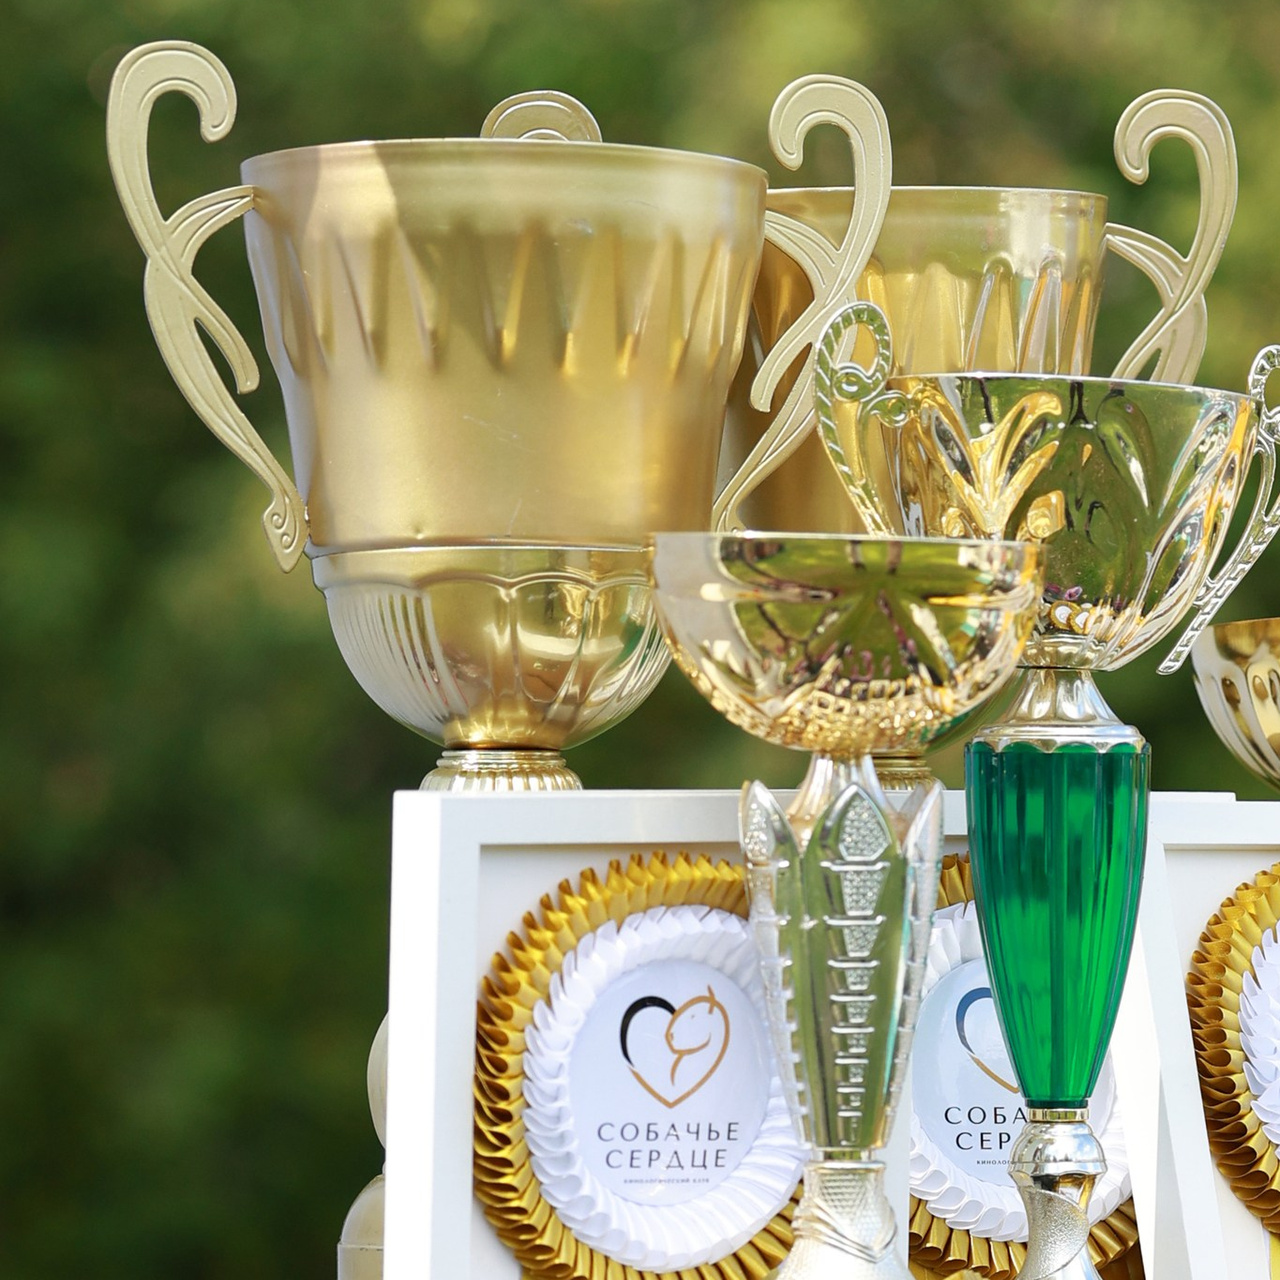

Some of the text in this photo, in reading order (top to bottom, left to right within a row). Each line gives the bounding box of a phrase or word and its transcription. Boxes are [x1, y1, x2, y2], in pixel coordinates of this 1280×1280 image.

[944, 1106, 1028, 1125] СОБА
[597, 1122, 740, 1142] СОБАЧЬЕ
[955, 1132, 1012, 1151] СЕР
[605, 1149, 728, 1171] СЕРДЦЕ
